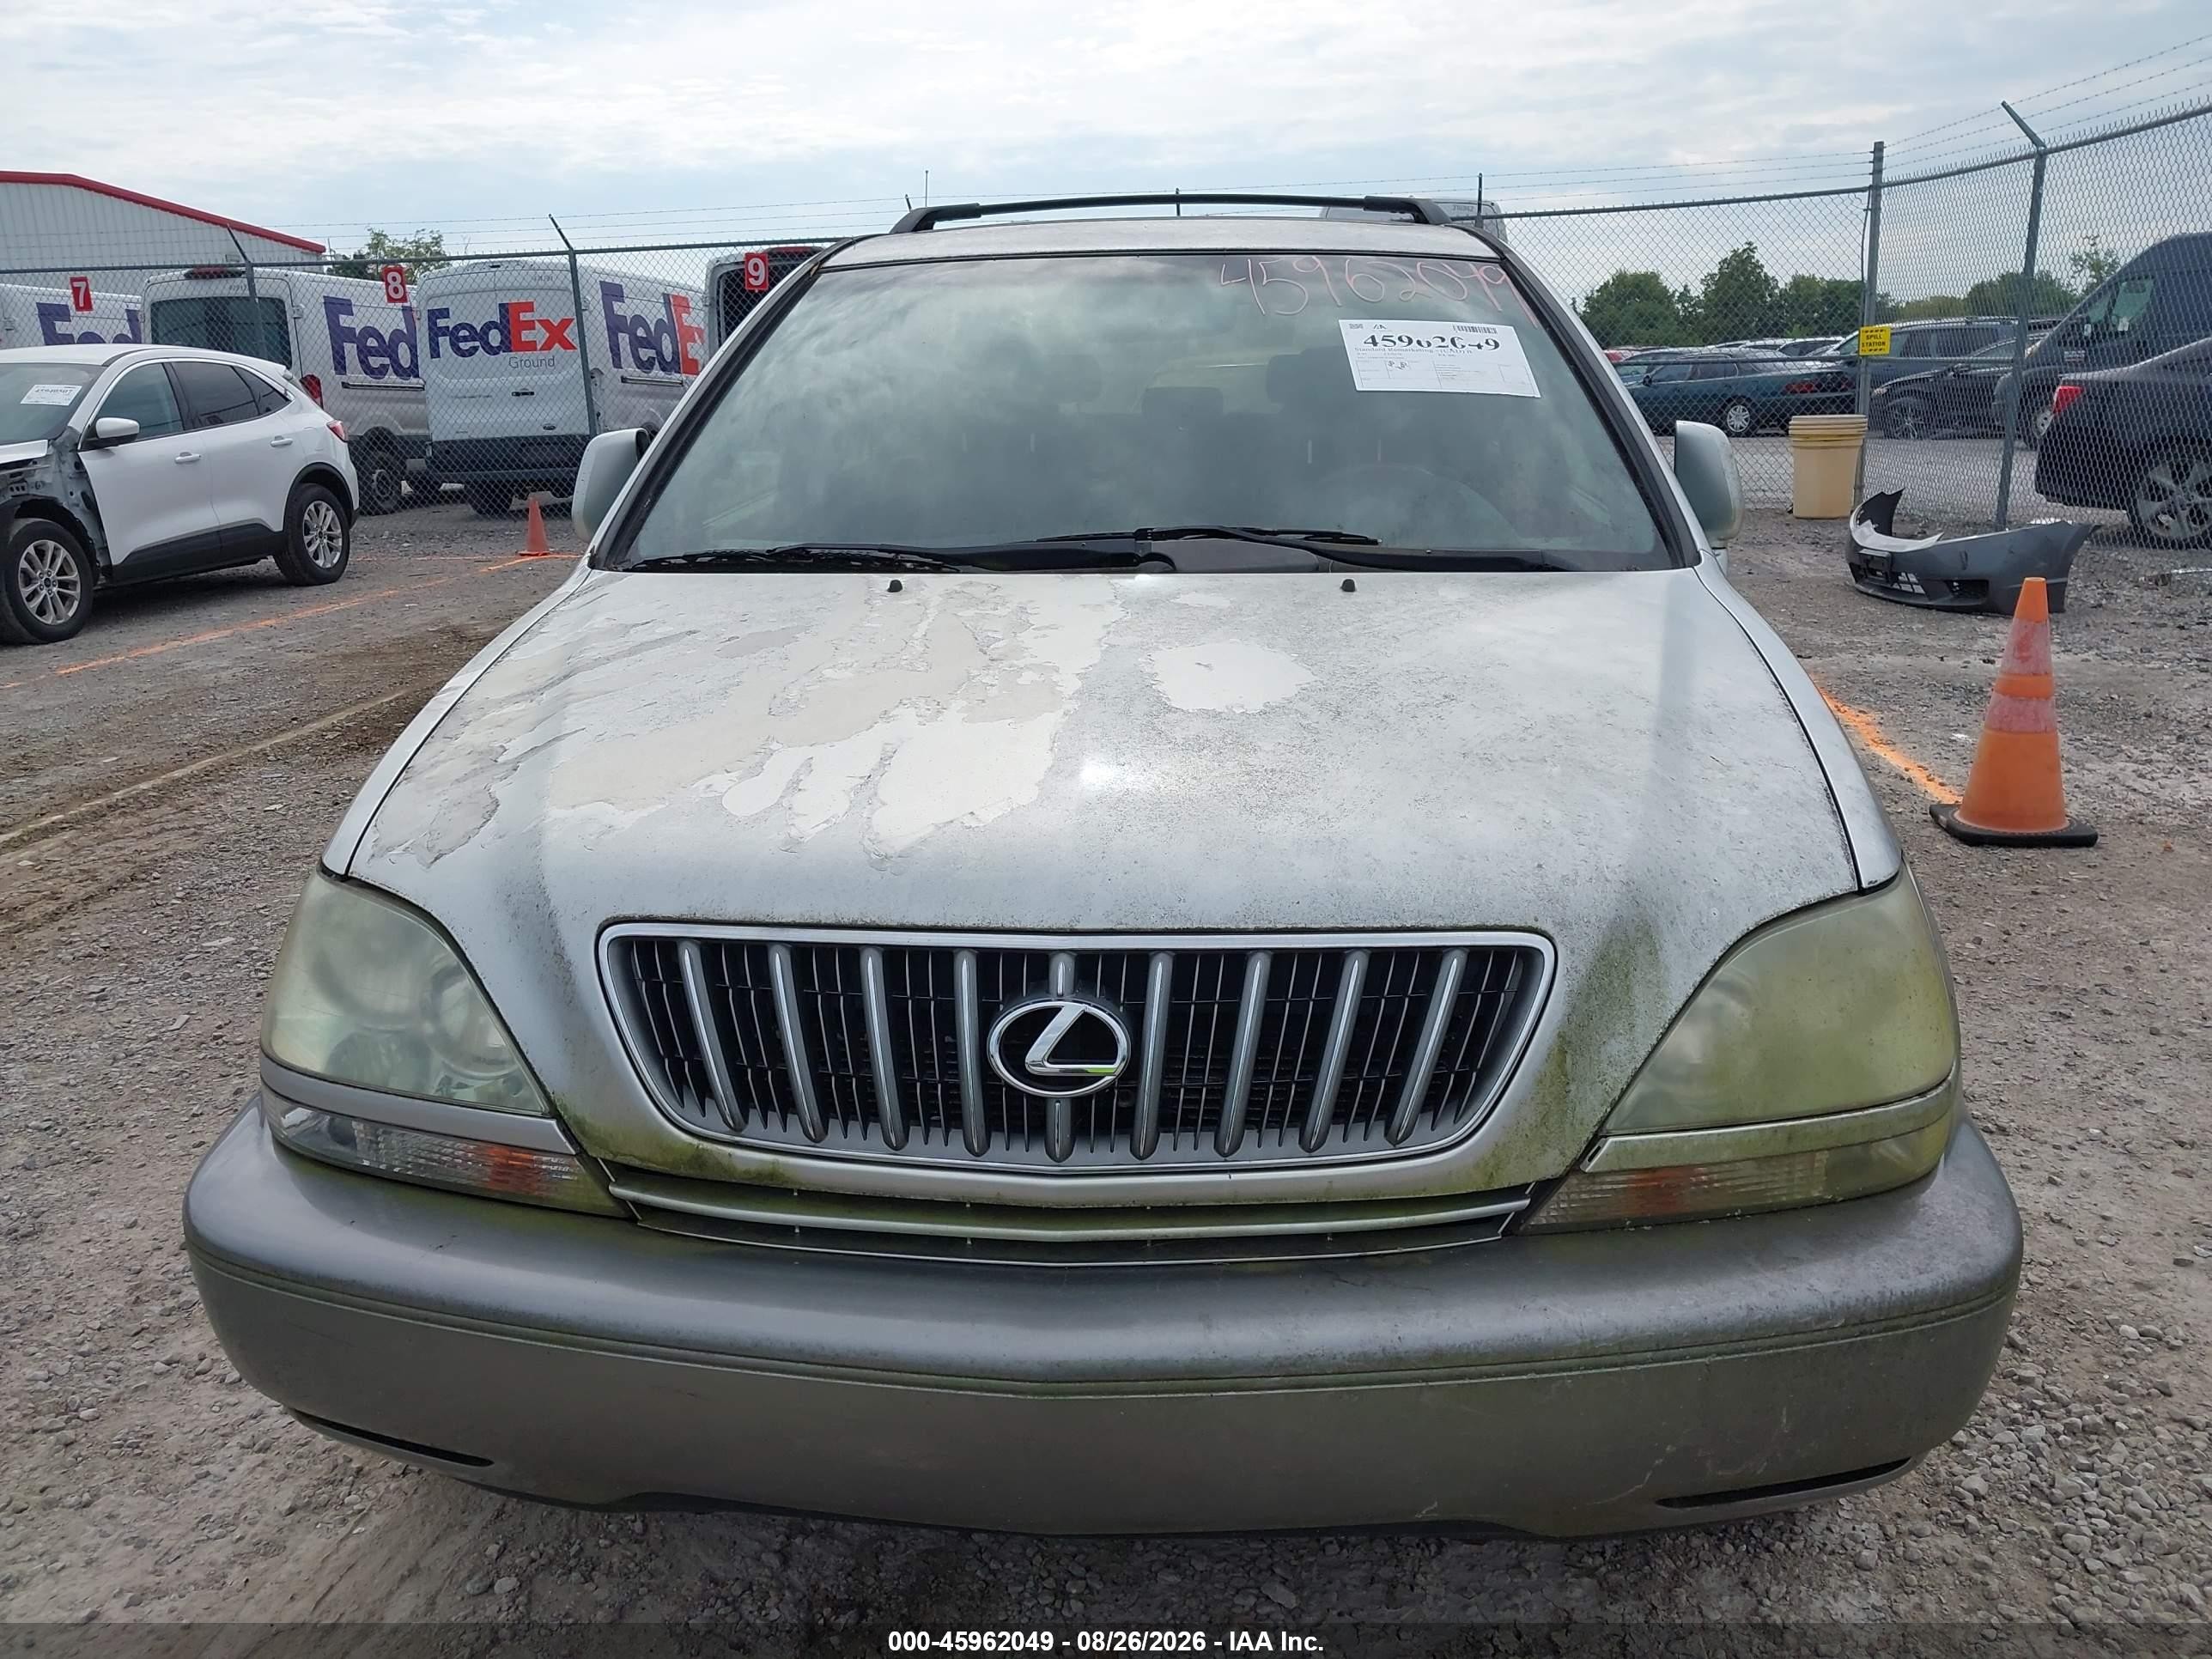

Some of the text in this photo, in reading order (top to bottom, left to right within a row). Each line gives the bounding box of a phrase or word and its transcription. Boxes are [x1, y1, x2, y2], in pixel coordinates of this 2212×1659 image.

[386, 271, 404, 299] 8
[747, 257, 766, 286] 9
[72, 281, 87, 307] 7
[1220, 255, 1539, 329] 45962049
[427, 301, 578, 359] FedEx
[599, 280, 705, 375] FedE
[508, 356, 556, 369] Ground
